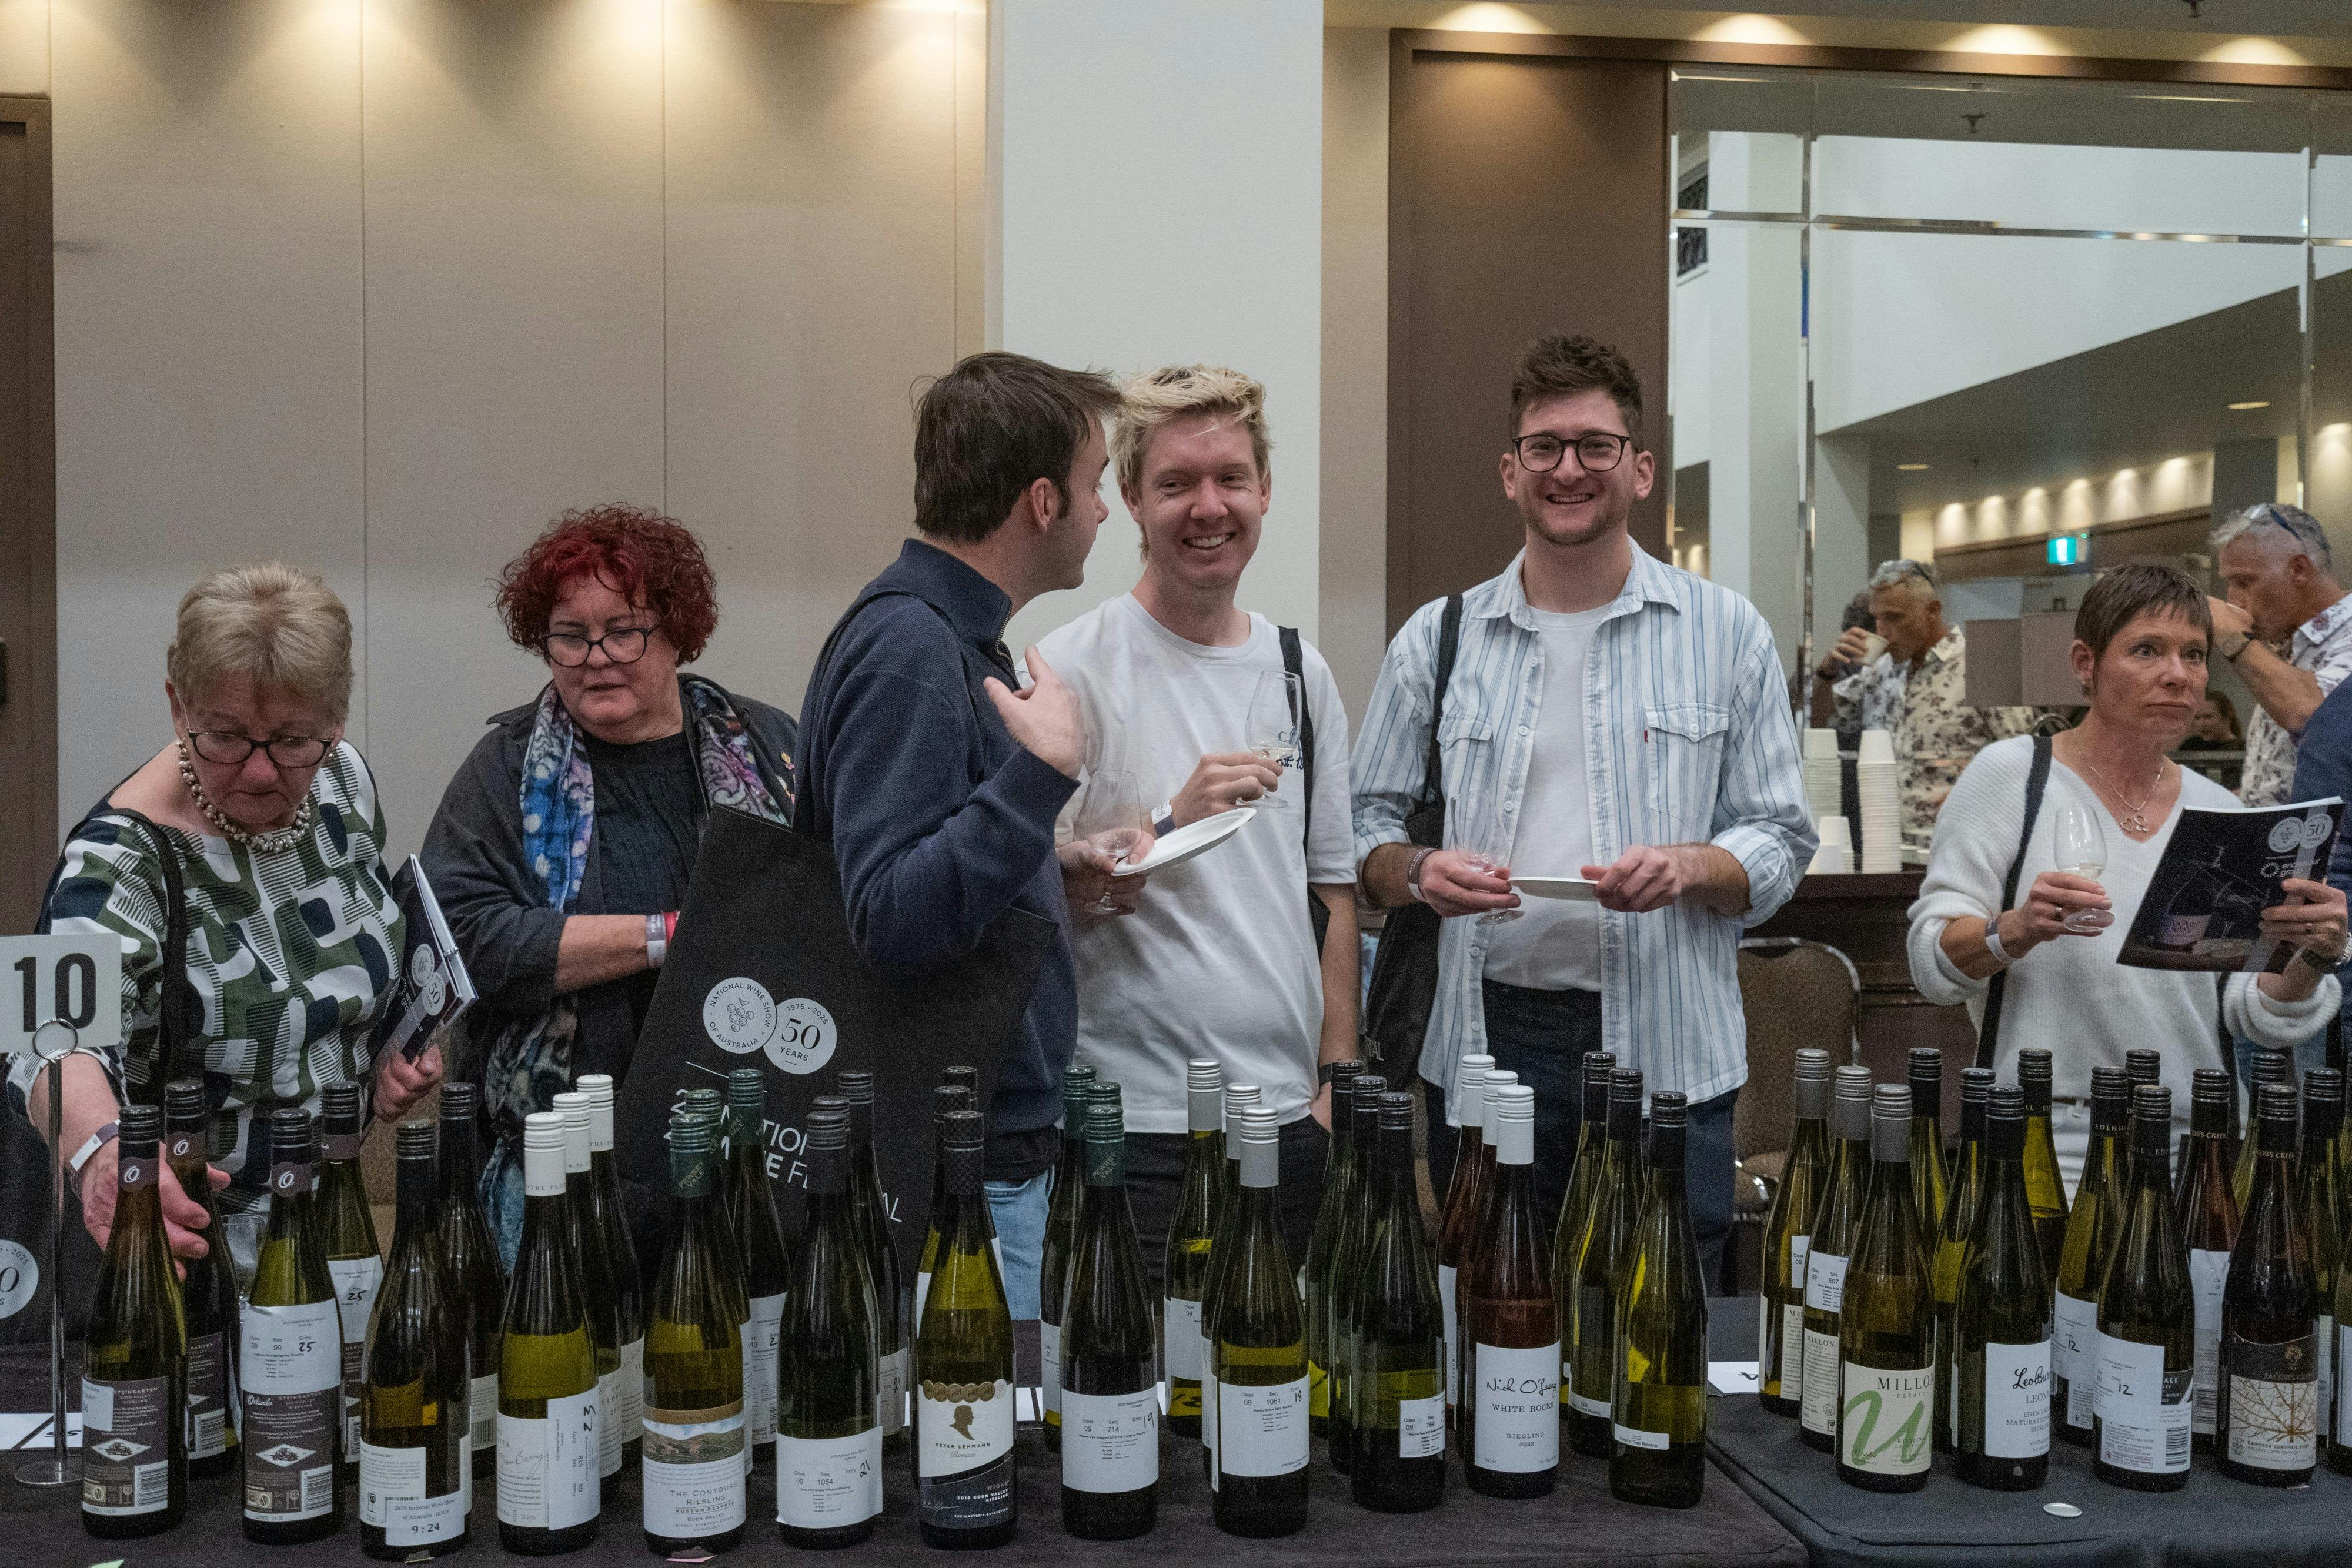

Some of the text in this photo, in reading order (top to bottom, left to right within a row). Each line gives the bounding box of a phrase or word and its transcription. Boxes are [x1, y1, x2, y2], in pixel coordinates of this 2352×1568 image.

[2307, 823, 2325, 837] 50
[15, 953, 96, 1032] 10
[710, 982, 743, 1007] NATIONAL
[747, 984, 764, 1000] WINE
[812, 1008, 828, 1025] 2025
[710, 1022, 759, 1048] OF AUSTRALIA
[781, 1018, 820, 1049] 50
[780, 1046, 808, 1061] YEARS
[11, 1249, 29, 1265] 2025
[0, 1267, 19, 1292] 0
[347, 1290, 367, 1301] 25
[299, 1342, 316, 1352] 25
[1807, 1335, 1834, 1347] MILLON
[2068, 1339, 2080, 1352] 12
[1486, 1378, 1515, 1392] Nick
[2119, 1383, 2133, 1396] 12
[248, 1395, 273, 1406] Orlando
[1295, 1390, 1302, 1402] 18
[1492, 1402, 1554, 1412] WHITE ROCKS
[583, 1405, 596, 1432] 23
[1143, 1412, 1154, 1429] 19
[860, 1459, 870, 1478] 21
[579, 1483, 583, 1492] 09
[693, 1482, 737, 1497] CONTOURS
[991, 1489, 1008, 1497] VALLEY
[687, 1495, 726, 1505] RIESLING
[985, 1493, 1008, 1502] RIESLING
[707, 1501, 734, 1511] RESERVE
